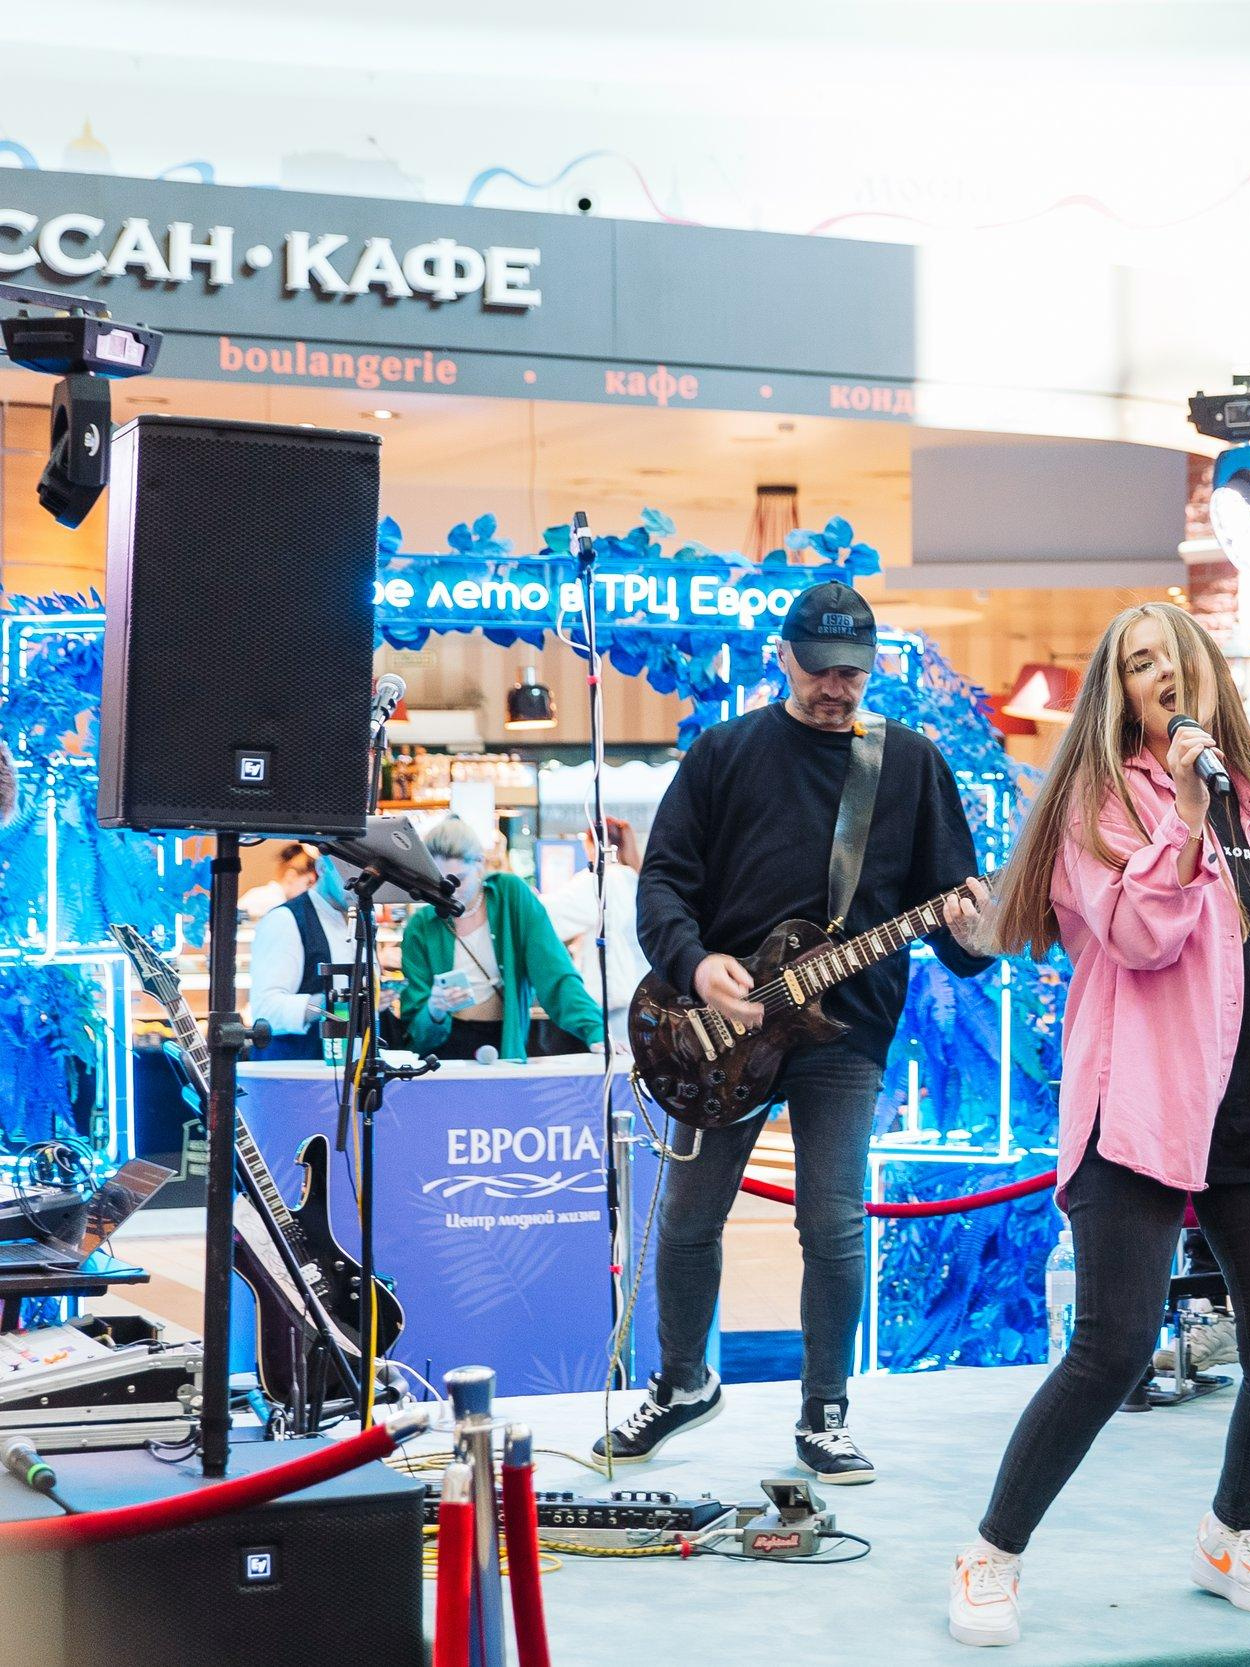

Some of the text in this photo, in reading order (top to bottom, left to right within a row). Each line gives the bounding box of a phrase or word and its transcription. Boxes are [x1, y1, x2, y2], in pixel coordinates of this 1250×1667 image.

[285, 230, 542, 309] КАФЕ
[218, 336, 457, 389] boulangerie
[605, 362, 699, 407] кафе
[427, 580, 550, 611] лето
[594, 573, 680, 622] ТРЦ
[690, 575, 801, 630] Евро
[447, 1125, 601, 1165] ЕВРОПА
[446, 1210, 601, 1231] Центр модной жизни
